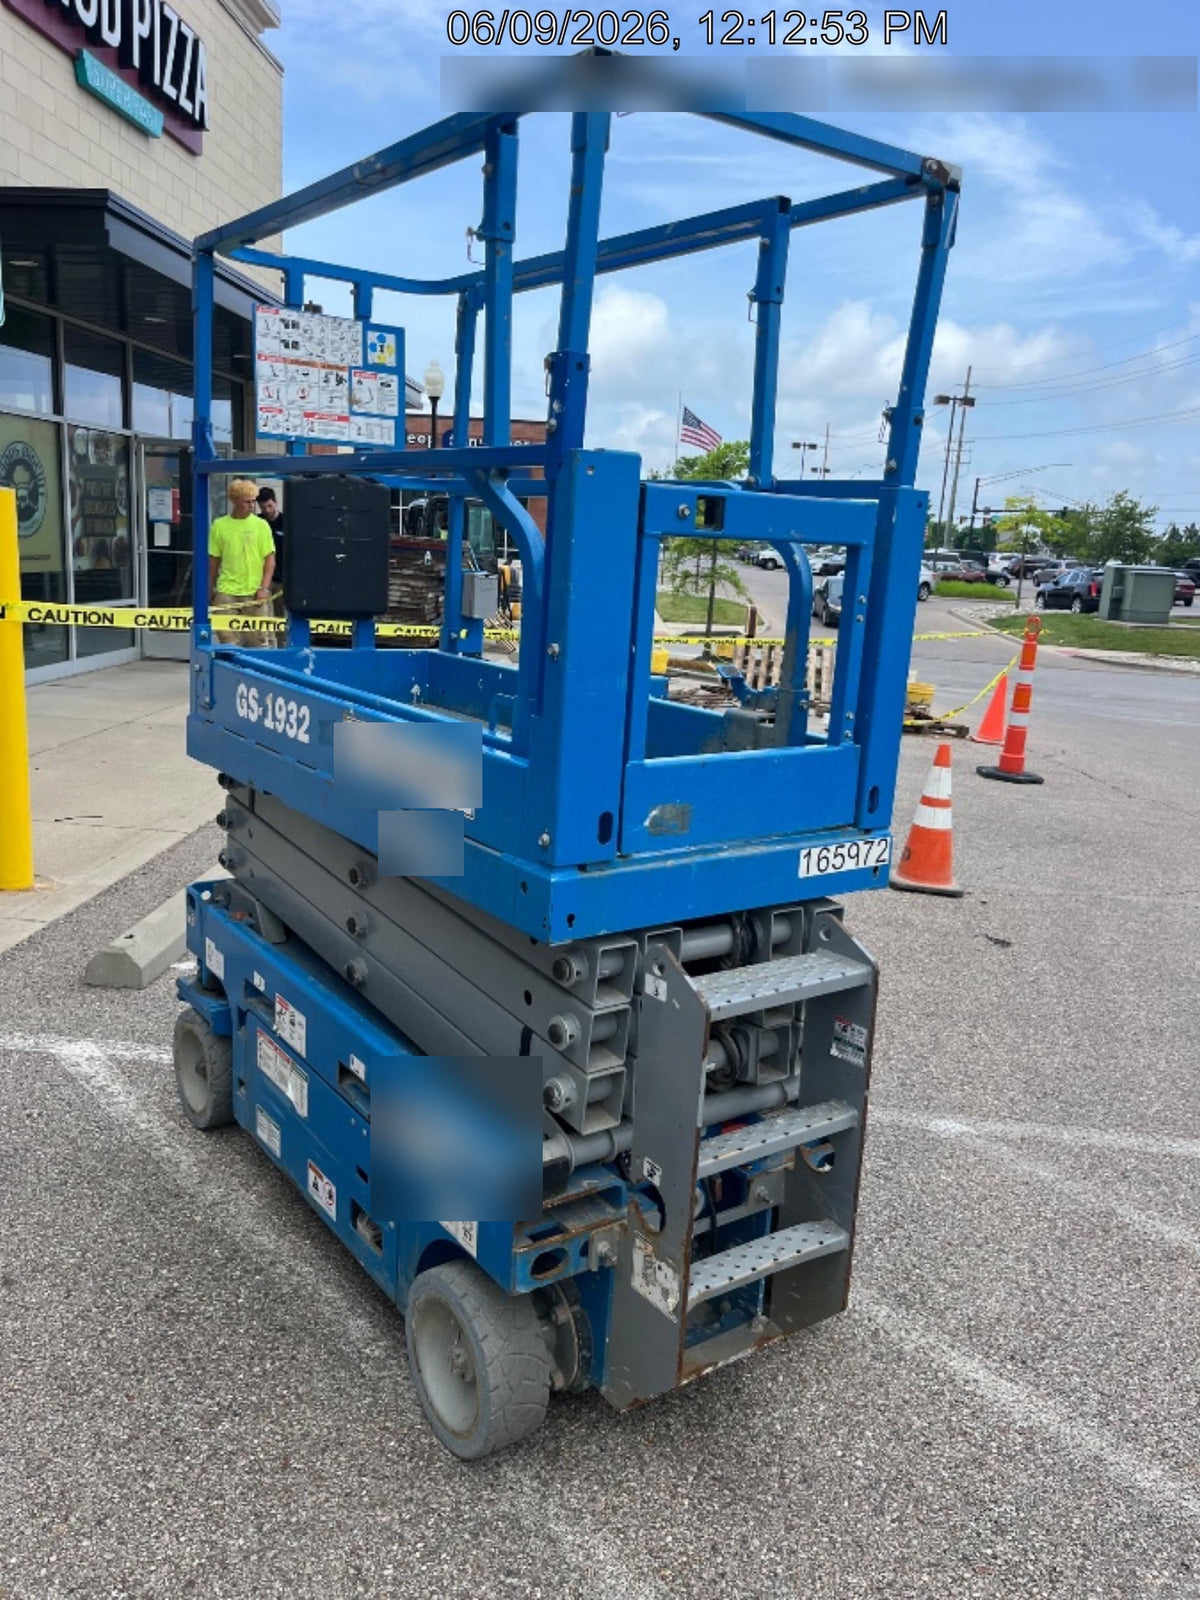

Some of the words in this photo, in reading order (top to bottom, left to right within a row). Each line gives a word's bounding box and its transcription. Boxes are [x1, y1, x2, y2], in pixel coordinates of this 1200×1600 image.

[133, 0, 208, 130] PIZZA
[28, 608, 114, 624] CAUTION
[134, 614, 194, 629] CAUTI
[236, 683, 310, 743] GS-1932
[803, 839, 889, 875] 165972
